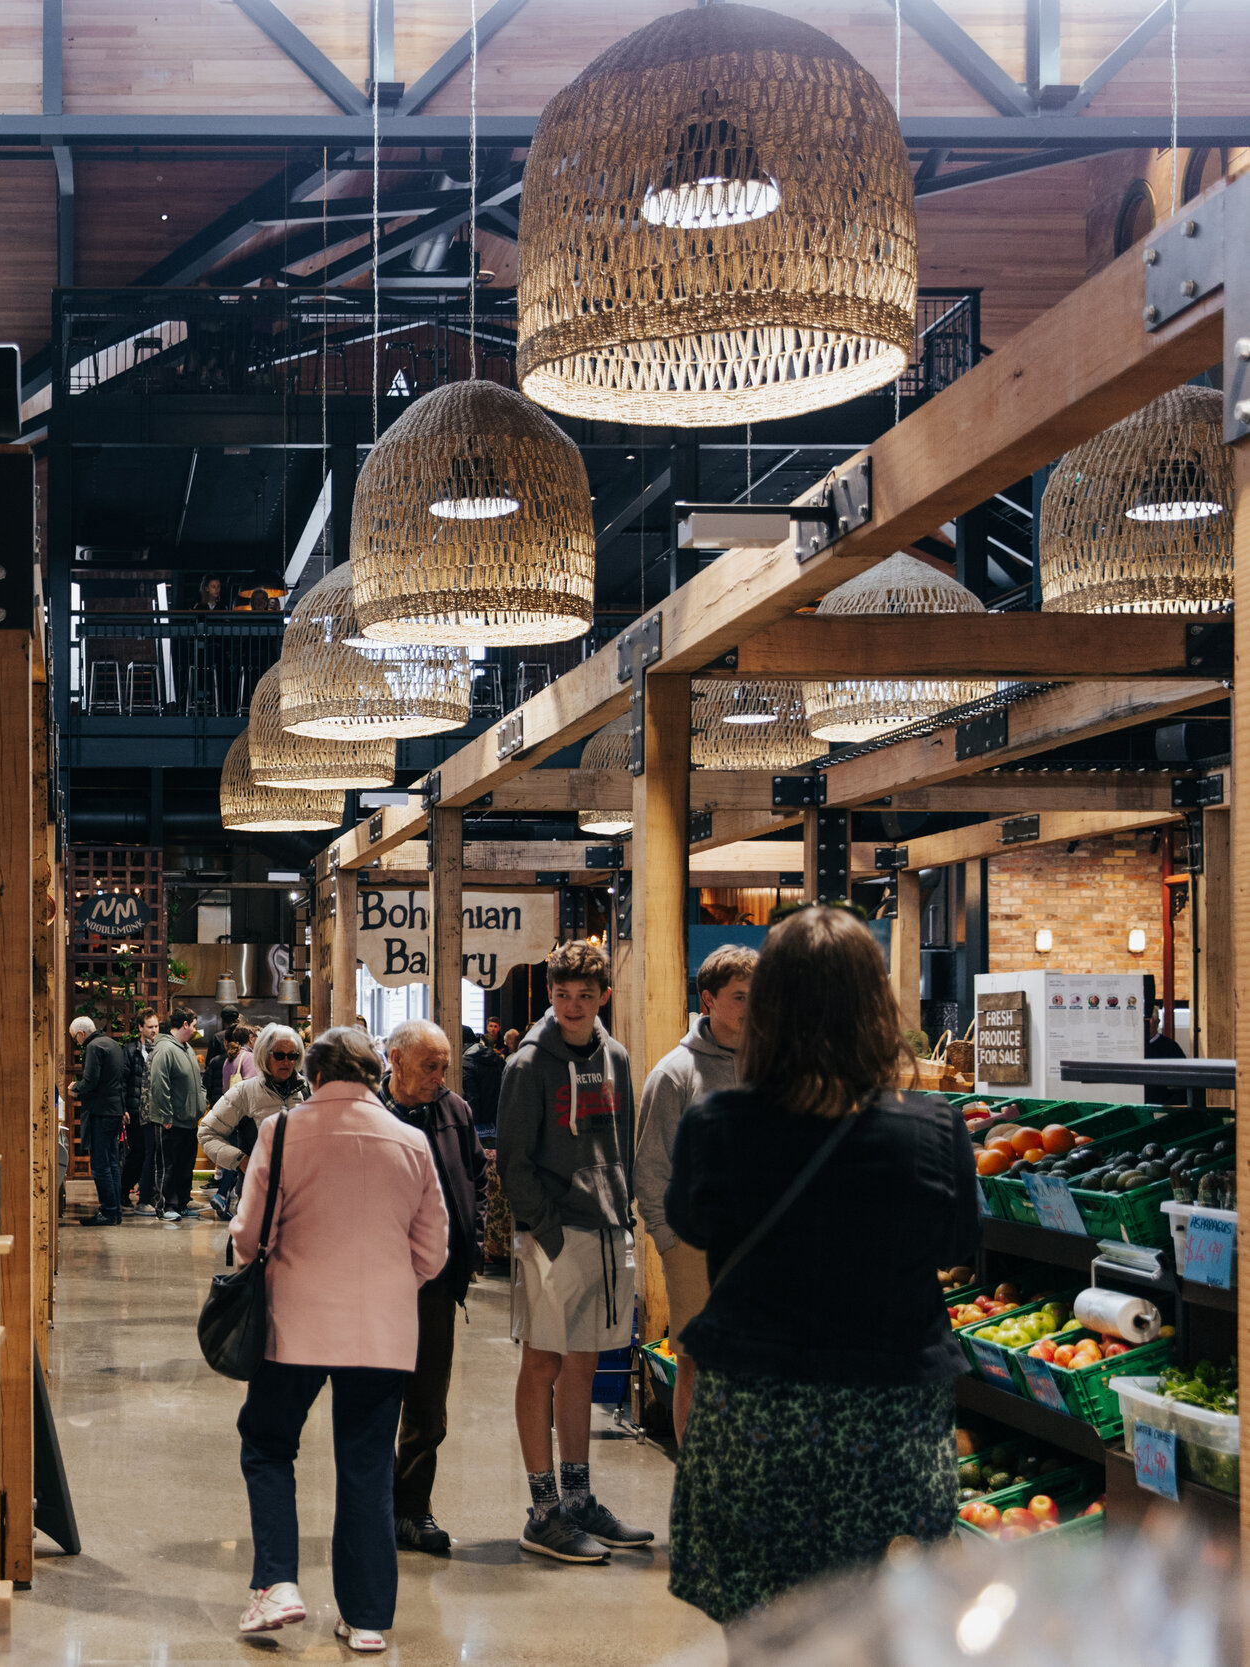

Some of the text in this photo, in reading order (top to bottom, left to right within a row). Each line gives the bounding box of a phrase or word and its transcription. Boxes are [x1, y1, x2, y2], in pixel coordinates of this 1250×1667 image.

[359, 891, 522, 931] Bohian
[83, 918, 146, 935] NOODLEMONK
[383, 937, 498, 989] Bary
[985, 1010, 1013, 1026] FRESH
[979, 1030, 1021, 1047] PRODUCE
[980, 1049, 1021, 1065] FOR SALE
[575, 1073, 603, 1085] RETRO
[1190, 1216, 1233, 1235] ASPARAGUS
